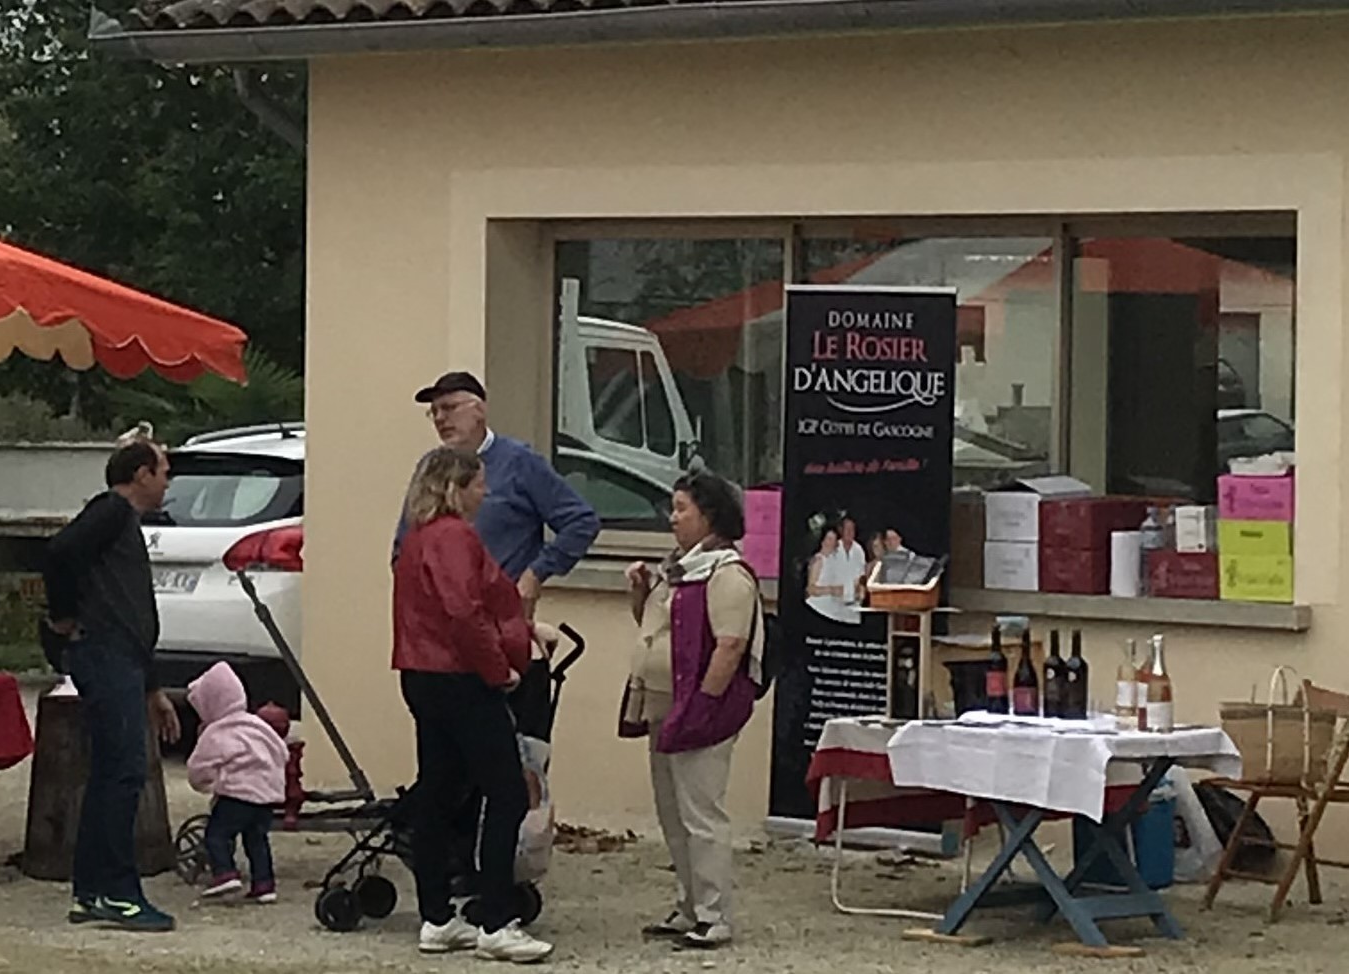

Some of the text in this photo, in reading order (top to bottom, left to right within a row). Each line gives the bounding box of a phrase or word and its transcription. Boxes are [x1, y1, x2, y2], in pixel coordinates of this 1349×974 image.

[828, 310, 915, 329] DOMAINE
[812, 330, 929, 363] LE ROSIER
[793, 362, 946, 404] D'ANGELIQUE
